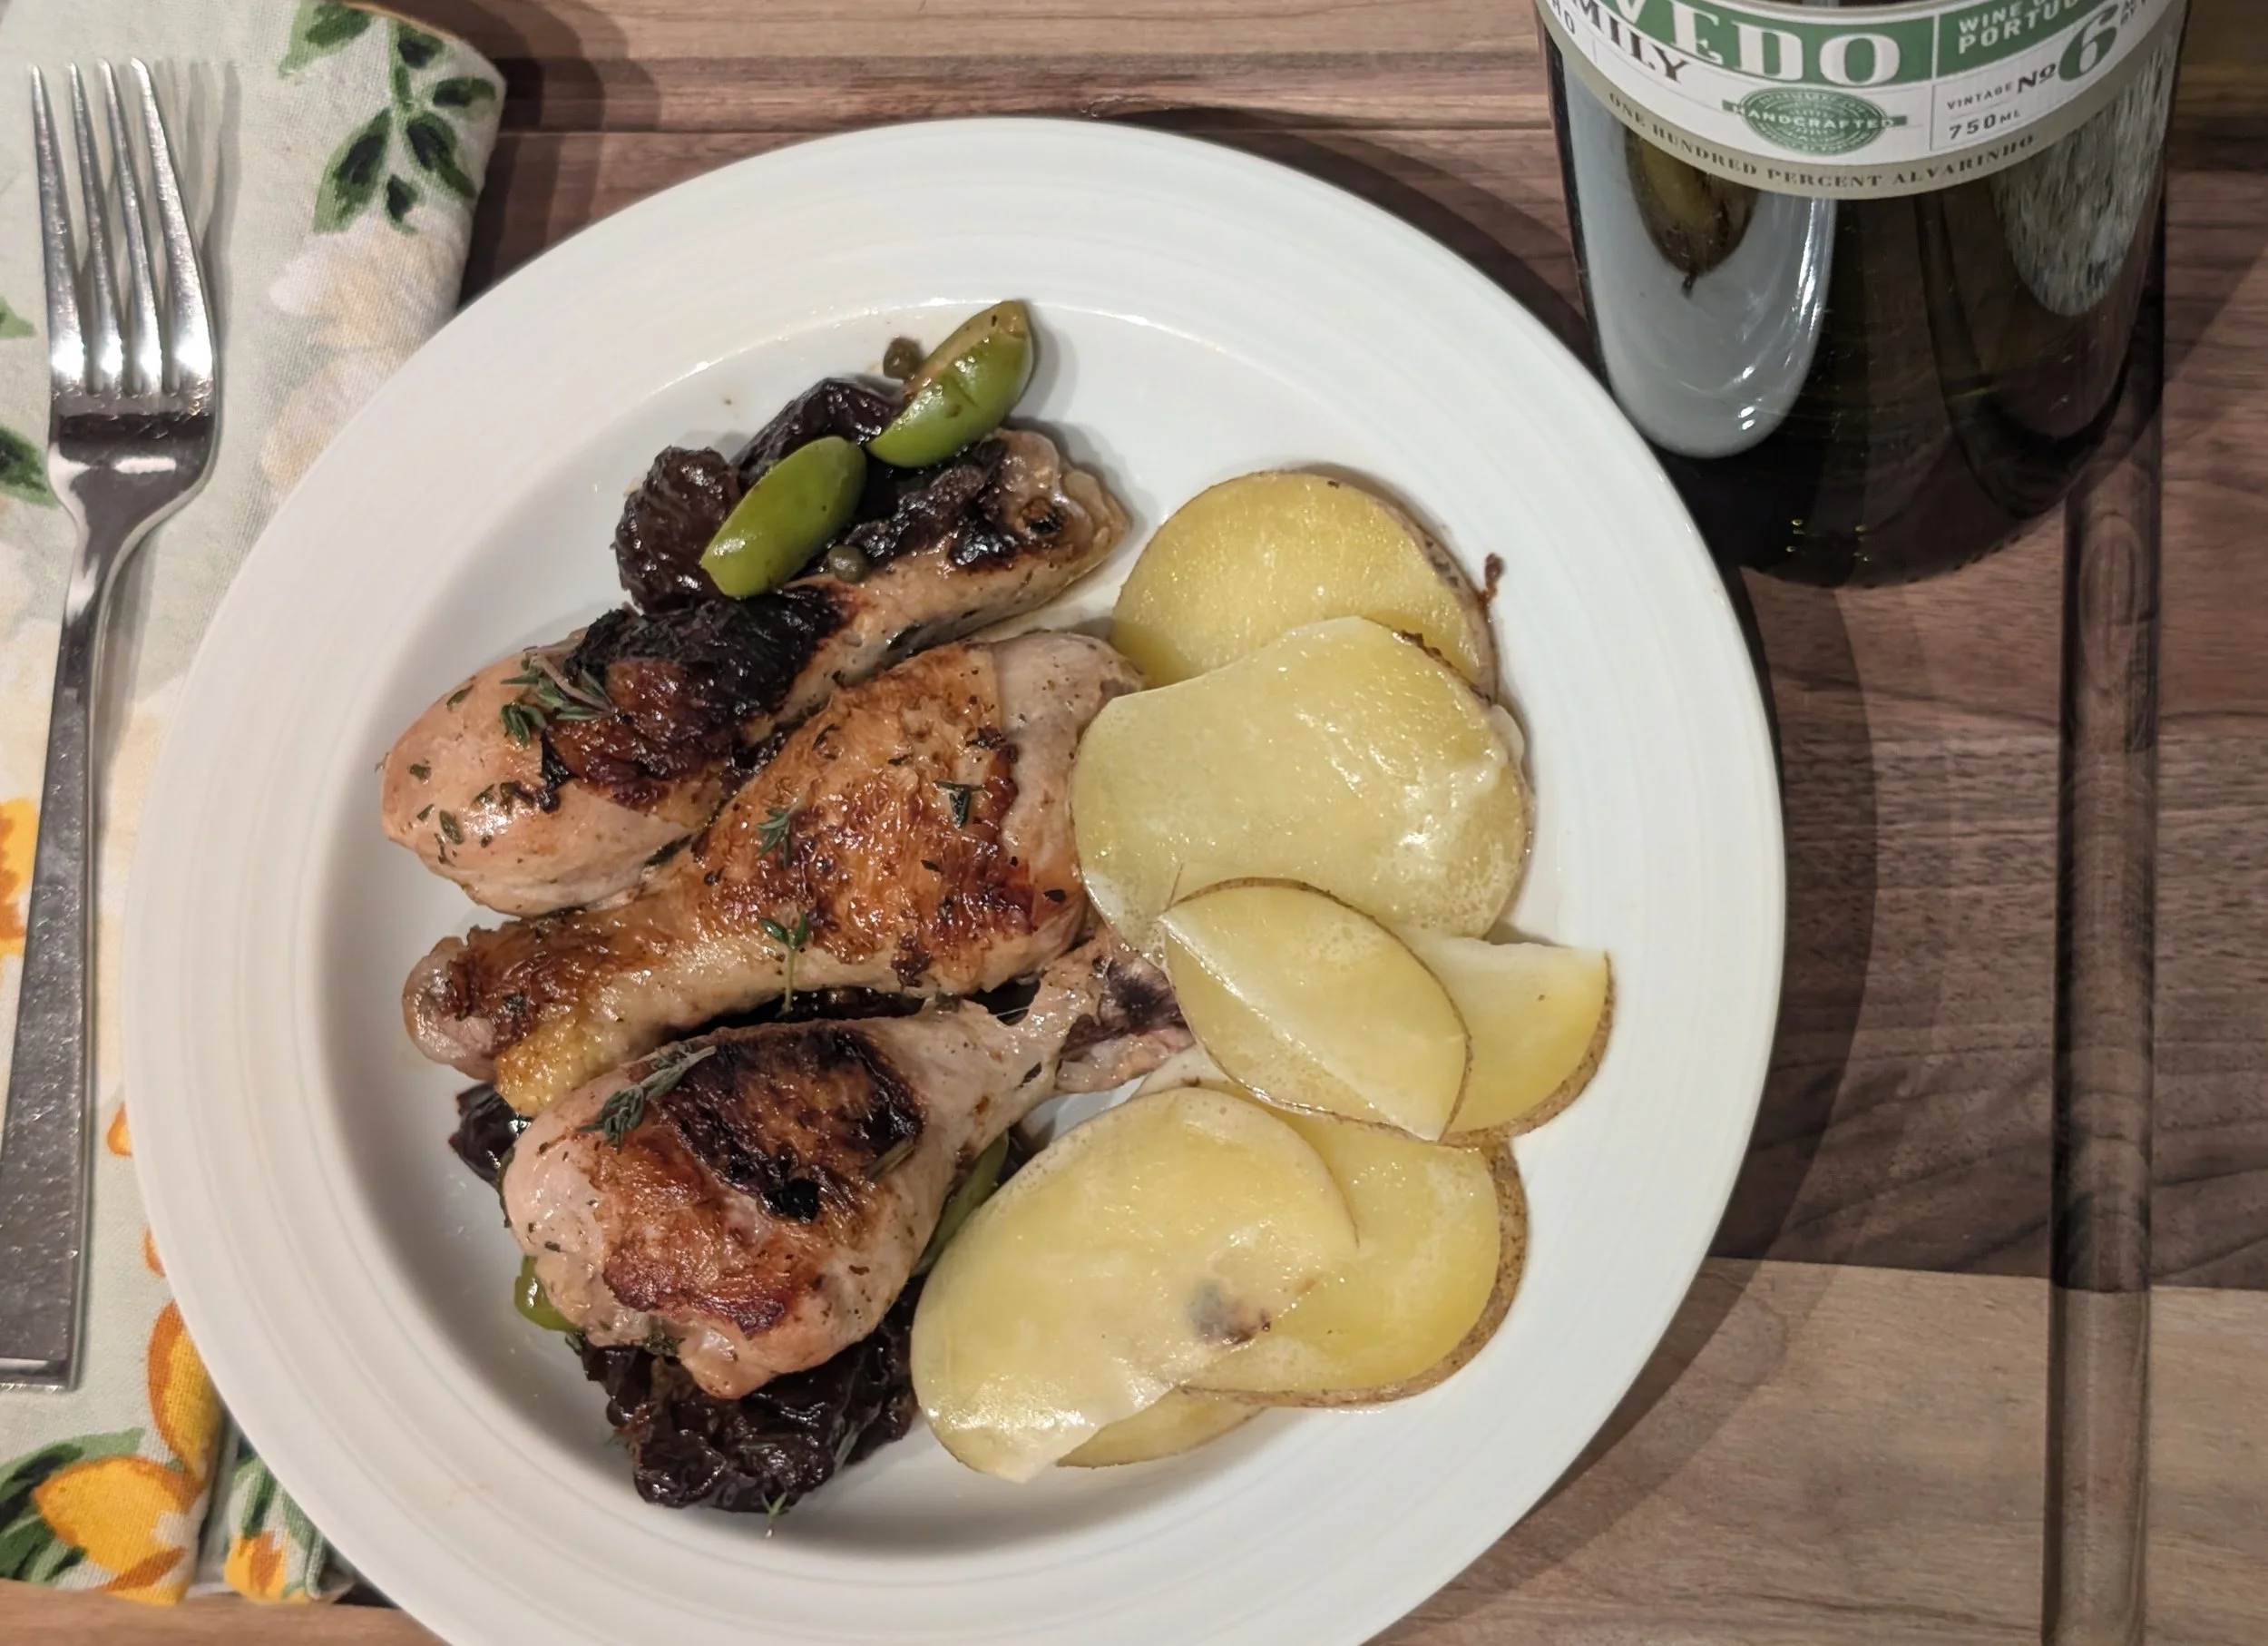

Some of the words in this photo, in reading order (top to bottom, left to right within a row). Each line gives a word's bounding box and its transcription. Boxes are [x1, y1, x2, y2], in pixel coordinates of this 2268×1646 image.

[1959, 1, 2023, 34] WINE
[1947, 82, 2013, 110] VINTAGE
[2058, 4, 2118, 81] 6
[1609, 93, 1646, 126] ONE
[1652, 124, 1757, 175] HUNDRED
[1767, 168, 1882, 187] PERCENT
[1896, 134, 2034, 185] ALVARINHO
[1733, 104, 1894, 129] HANDCRAFTED
